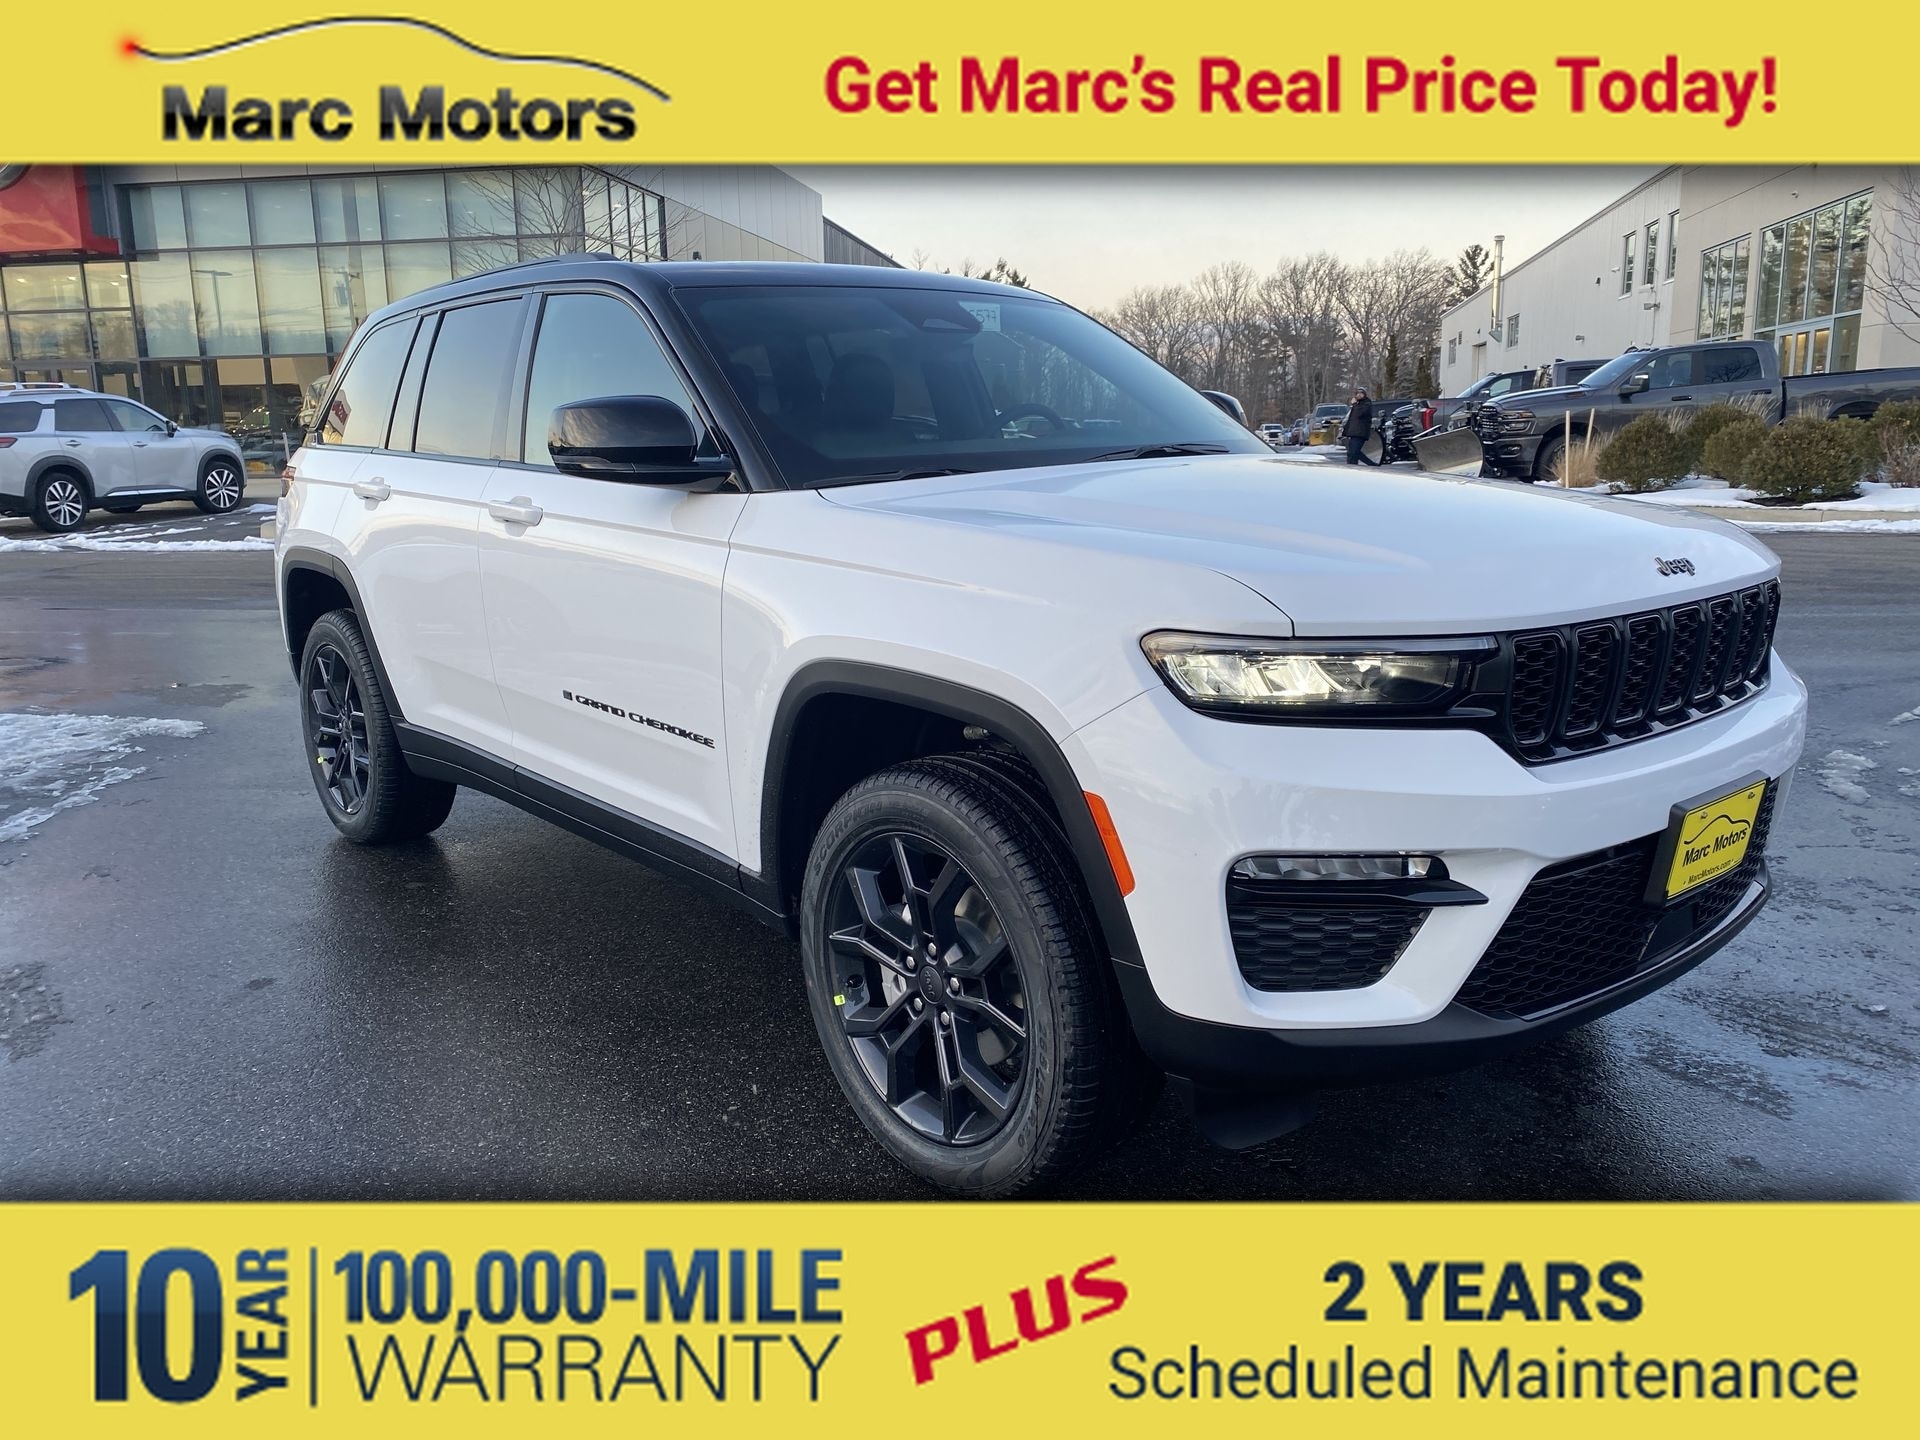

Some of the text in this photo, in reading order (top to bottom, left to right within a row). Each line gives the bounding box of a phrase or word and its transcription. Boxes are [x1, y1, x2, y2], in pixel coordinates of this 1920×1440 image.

[1655, 557, 1696, 577] Jeep
[575, 695, 716, 749] GRAND CHEROKEE
[1682, 827, 1748, 867] Marc Motors
